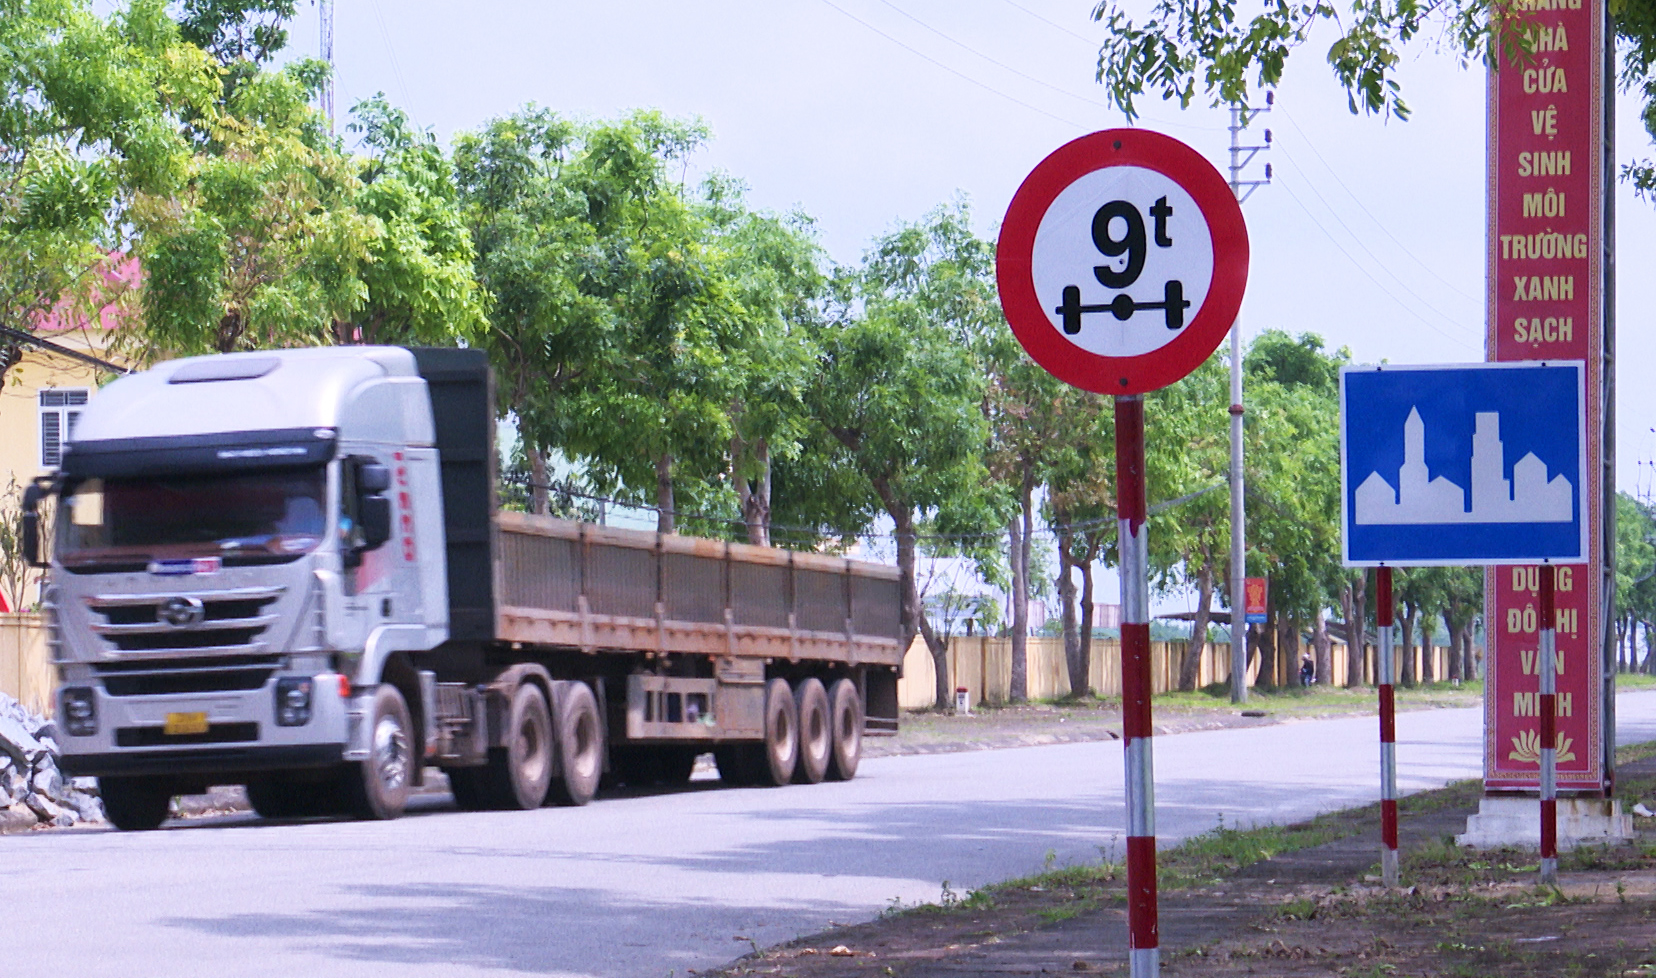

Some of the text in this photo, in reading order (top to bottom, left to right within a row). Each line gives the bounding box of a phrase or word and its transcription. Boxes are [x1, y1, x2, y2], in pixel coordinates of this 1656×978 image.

[1523, 58, 1568, 94] CỬA
[1531, 104, 1558, 140] VỆ
[1518, 150, 1571, 177] SINH
[1523, 187, 1566, 218] MÔI
[1500, 228, 1588, 259] TRƯỜNG
[1513, 276, 1574, 301] XANH
[1514, 316, 1573, 349] SẠCH
[1507, 602, 1578, 640] ĐÔ HỊ
[1513, 692, 1572, 718] MIH
